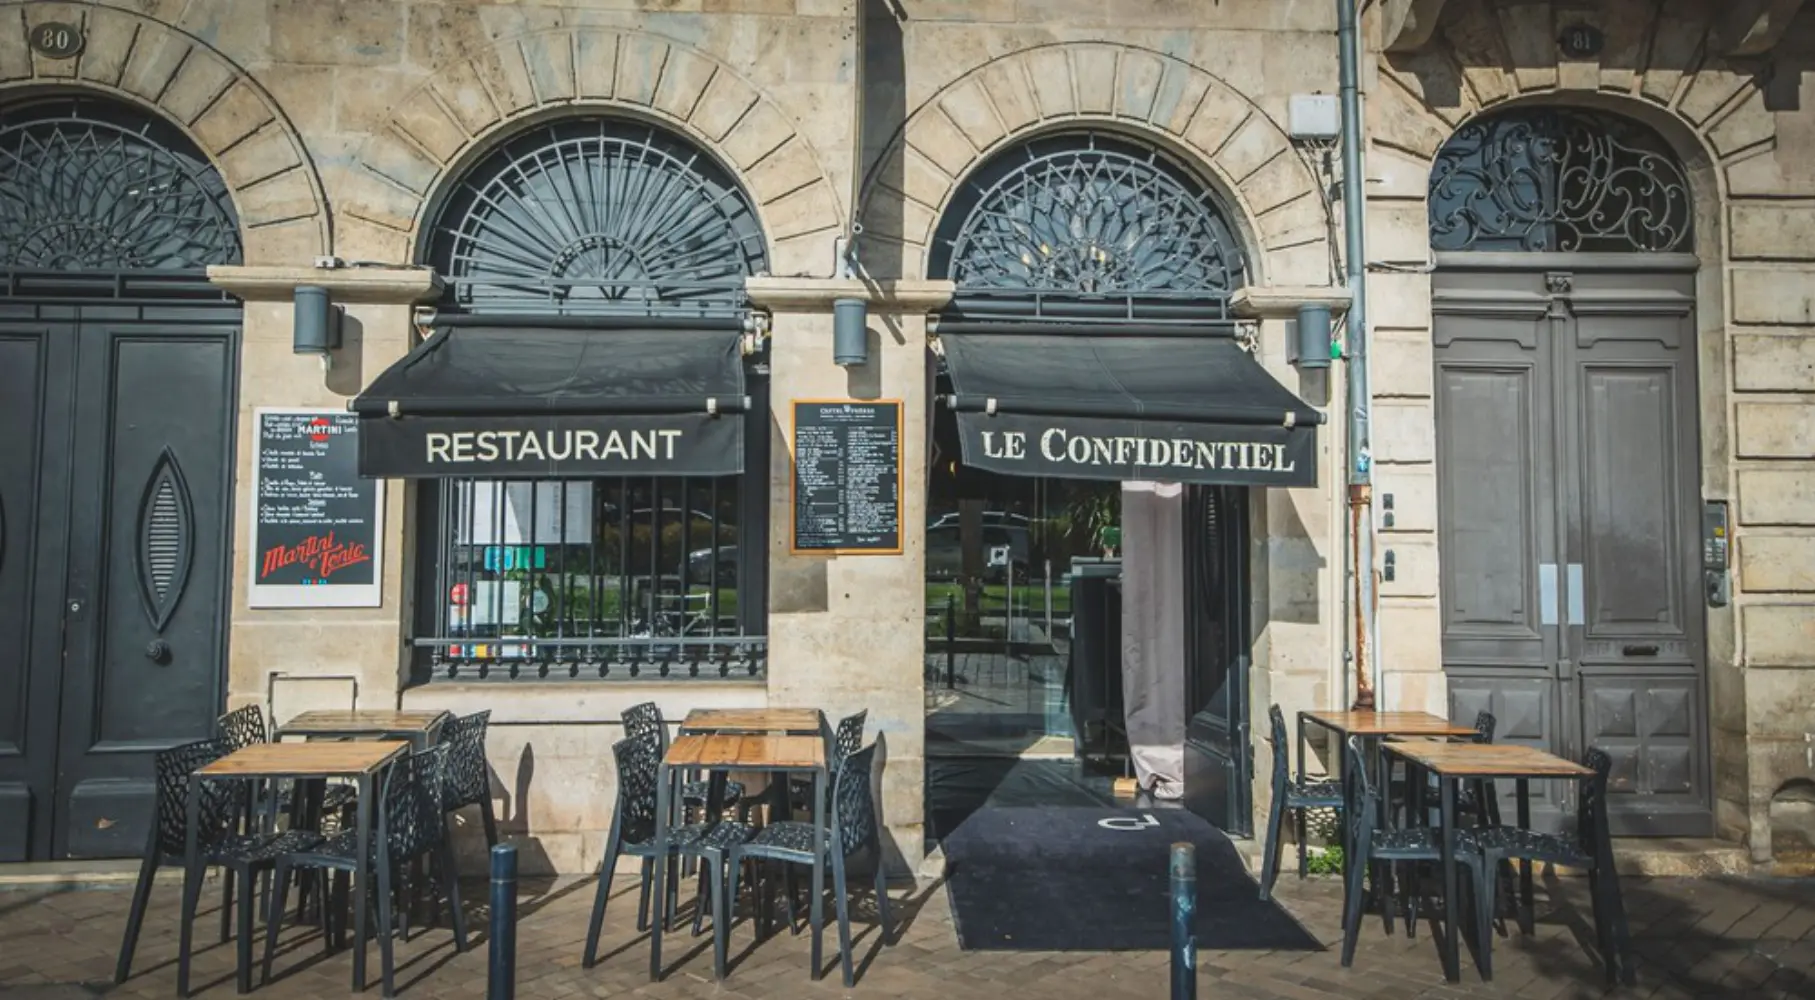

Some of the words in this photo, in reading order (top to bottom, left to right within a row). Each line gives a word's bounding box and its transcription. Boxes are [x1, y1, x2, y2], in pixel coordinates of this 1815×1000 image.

[42, 29, 68, 49] 80
[1573, 31, 1590, 50] 81
[297, 425, 342, 435] MARTINI
[426, 430, 682, 463] RESTAURANT
[981, 431, 1026, 460] LE
[1040, 428, 1295, 472] CONFIDENTIEL
[261, 530, 335, 578] Martini
[320, 542, 371, 578] Tonic
